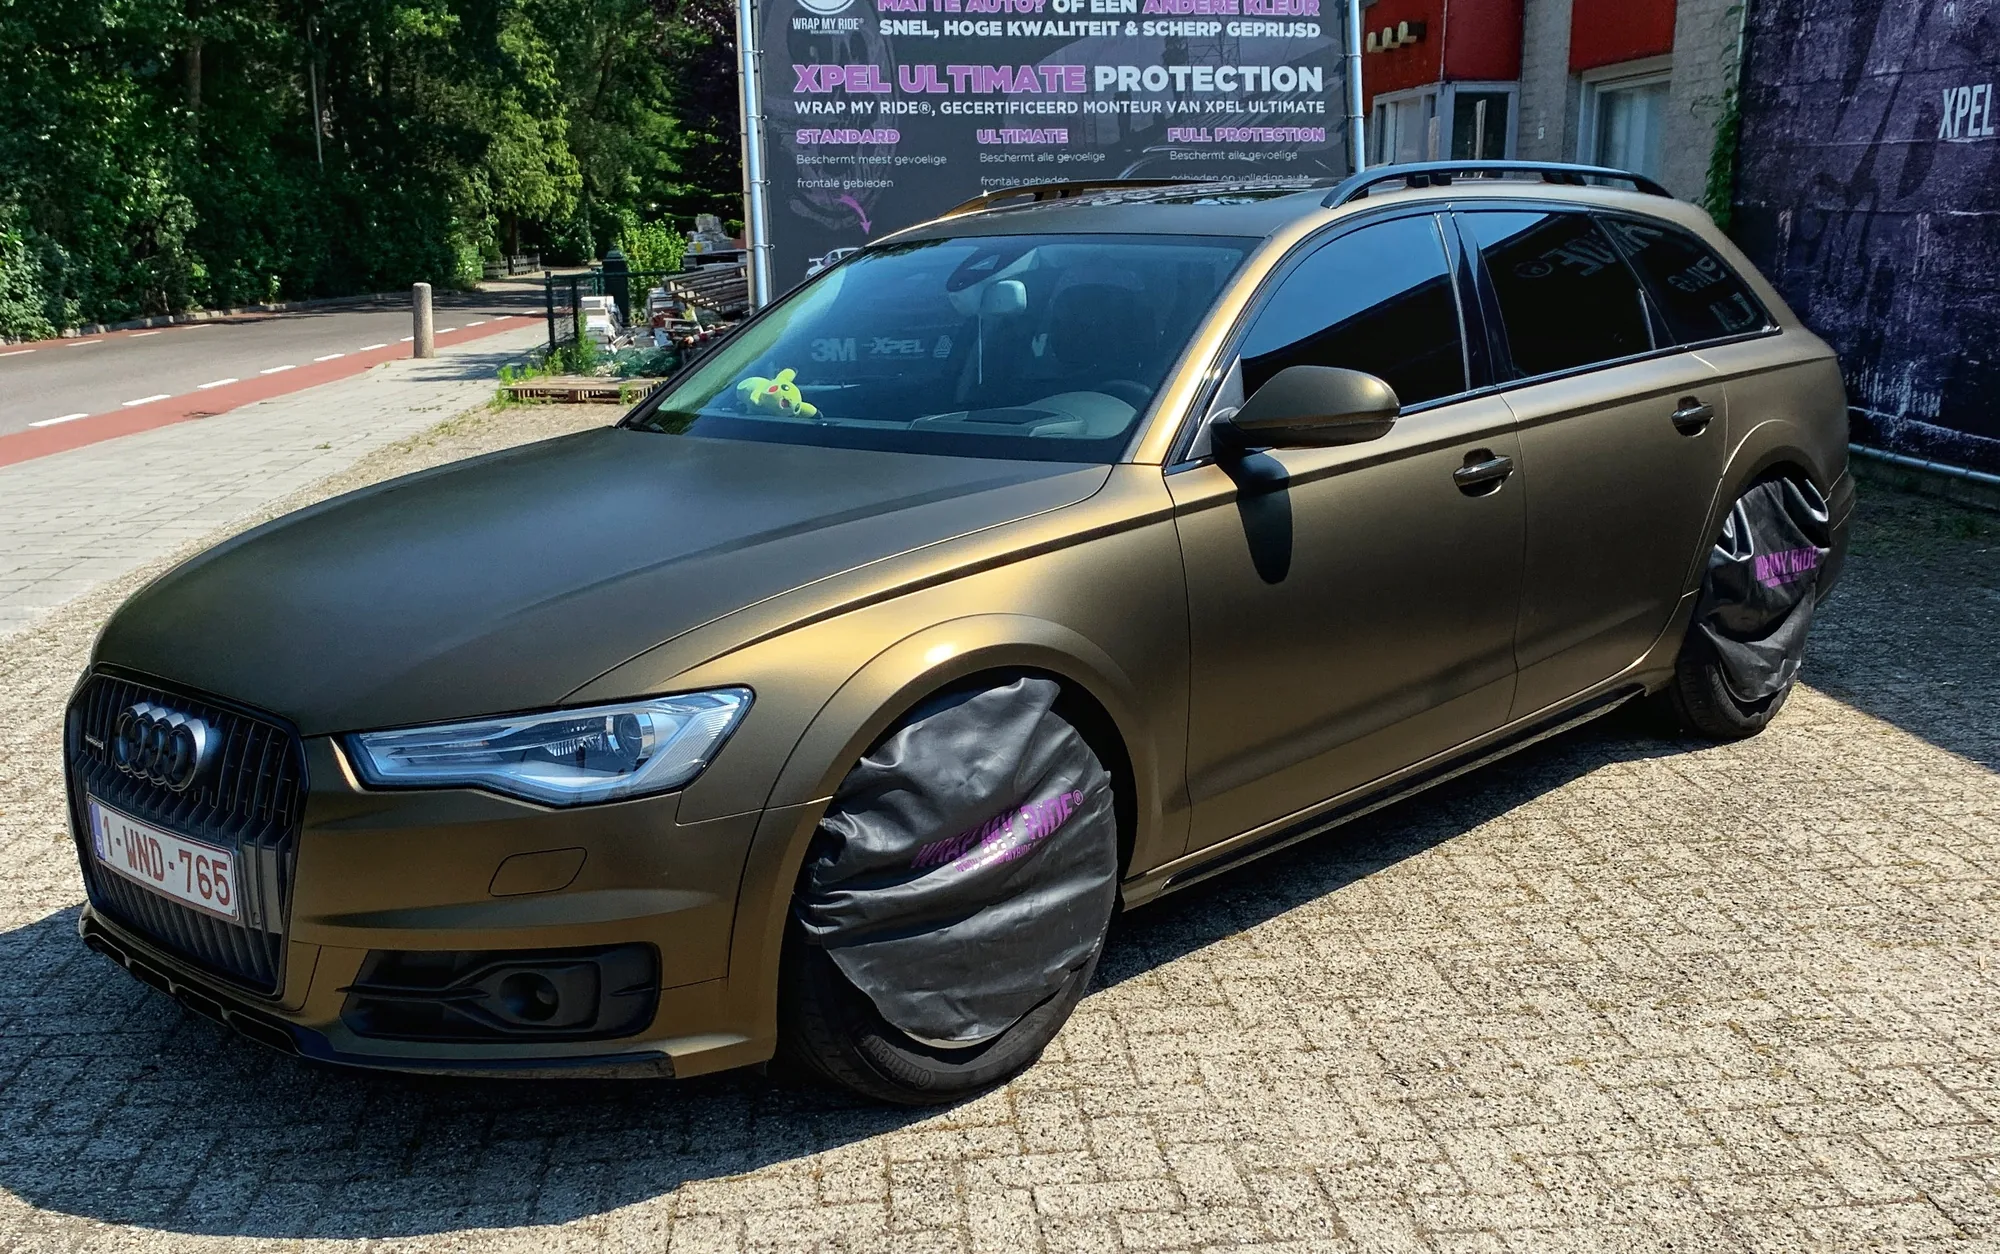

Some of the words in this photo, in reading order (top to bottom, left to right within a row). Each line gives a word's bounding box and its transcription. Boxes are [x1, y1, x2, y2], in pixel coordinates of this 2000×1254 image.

[877, 0, 961, 12] MATTE
[965, 0, 1045, 13] AUTO?
[1052, 0, 1085, 13] OF
[1090, 0, 1137, 14] EEN
[1142, 0, 1240, 15] ANDERE
[1243, 0, 1320, 16] KLEUR
[793, 18, 819, 30] WRAP
[822, 18, 836, 30] MY
[879, 19, 940, 38] SNEL,
[944, 20, 1003, 36] HOGE
[1007, 20, 1120, 37] KWALITEIT
[1124, 21, 1138, 36] &
[1142, 21, 1222, 37] SCHERP
[1226, 21, 1321, 38] GEPRIJSD
[792, 64, 892, 93] XPEL
[898, 64, 1087, 94] ULTIMATE
[1094, 65, 1323, 93] PROTECTION
[794, 101, 846, 114] WRAP
[851, 101, 875, 114] MY
[940, 101, 1079, 115] GECERTIFICEERD
[1083, 100, 1162, 114] MONTEUR
[1166, 100, 1200, 114] VAN
[1205, 100, 1244, 114] XPEL
[1248, 100, 1326, 114] ULTIMATE
[1938, 83, 1994, 139] XPEL
[796, 129, 901, 145] STANDARD
[976, 128, 1069, 144] ULTIMATE
[1168, 127, 1212, 142] FULL
[1214, 127, 1326, 142] PROTECTION
[796, 154, 855, 165] Beschermt
[858, 155, 892, 165] meest
[895, 154, 947, 166] gevoelige
[979, 152, 1035, 163] Beschermt
[1037, 152, 1054, 162] alle
[1057, 152, 1106, 164] gevoelige
[1170, 150, 1225, 160] Beschermt
[1228, 150, 1246, 160] alle
[1248, 150, 1298, 162] gevoelige
[797, 177, 840, 188] frontale
[843, 177, 894, 190] gebieden
[980, 176, 1020, 186] frontale
[811, 337, 857, 362] 3M
[104, 815, 231, 906] 1-WND-765
